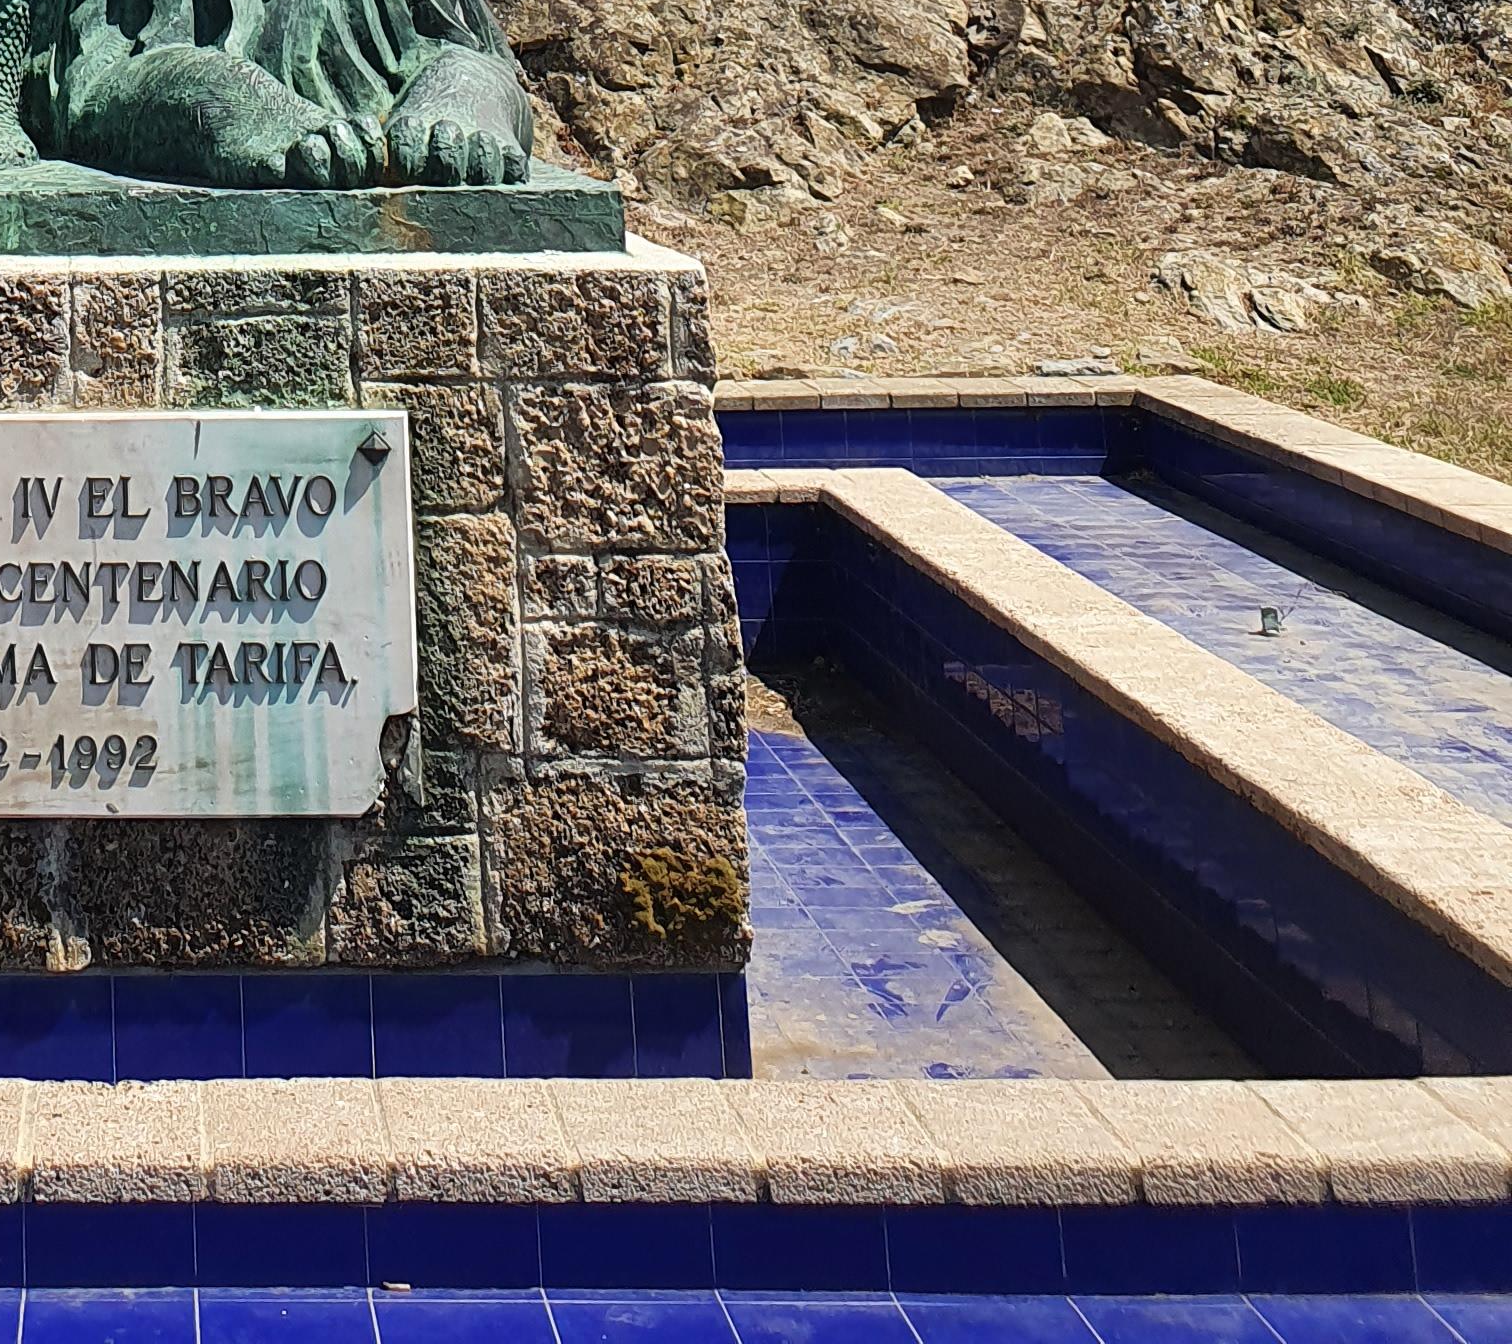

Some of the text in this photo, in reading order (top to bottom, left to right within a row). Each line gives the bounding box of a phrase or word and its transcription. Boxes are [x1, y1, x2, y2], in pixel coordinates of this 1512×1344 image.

[20, 476, 63, 519] IV
[87, 475, 151, 519] EL
[174, 474, 337, 517] BRAVO
[88, 642, 154, 685] DE
